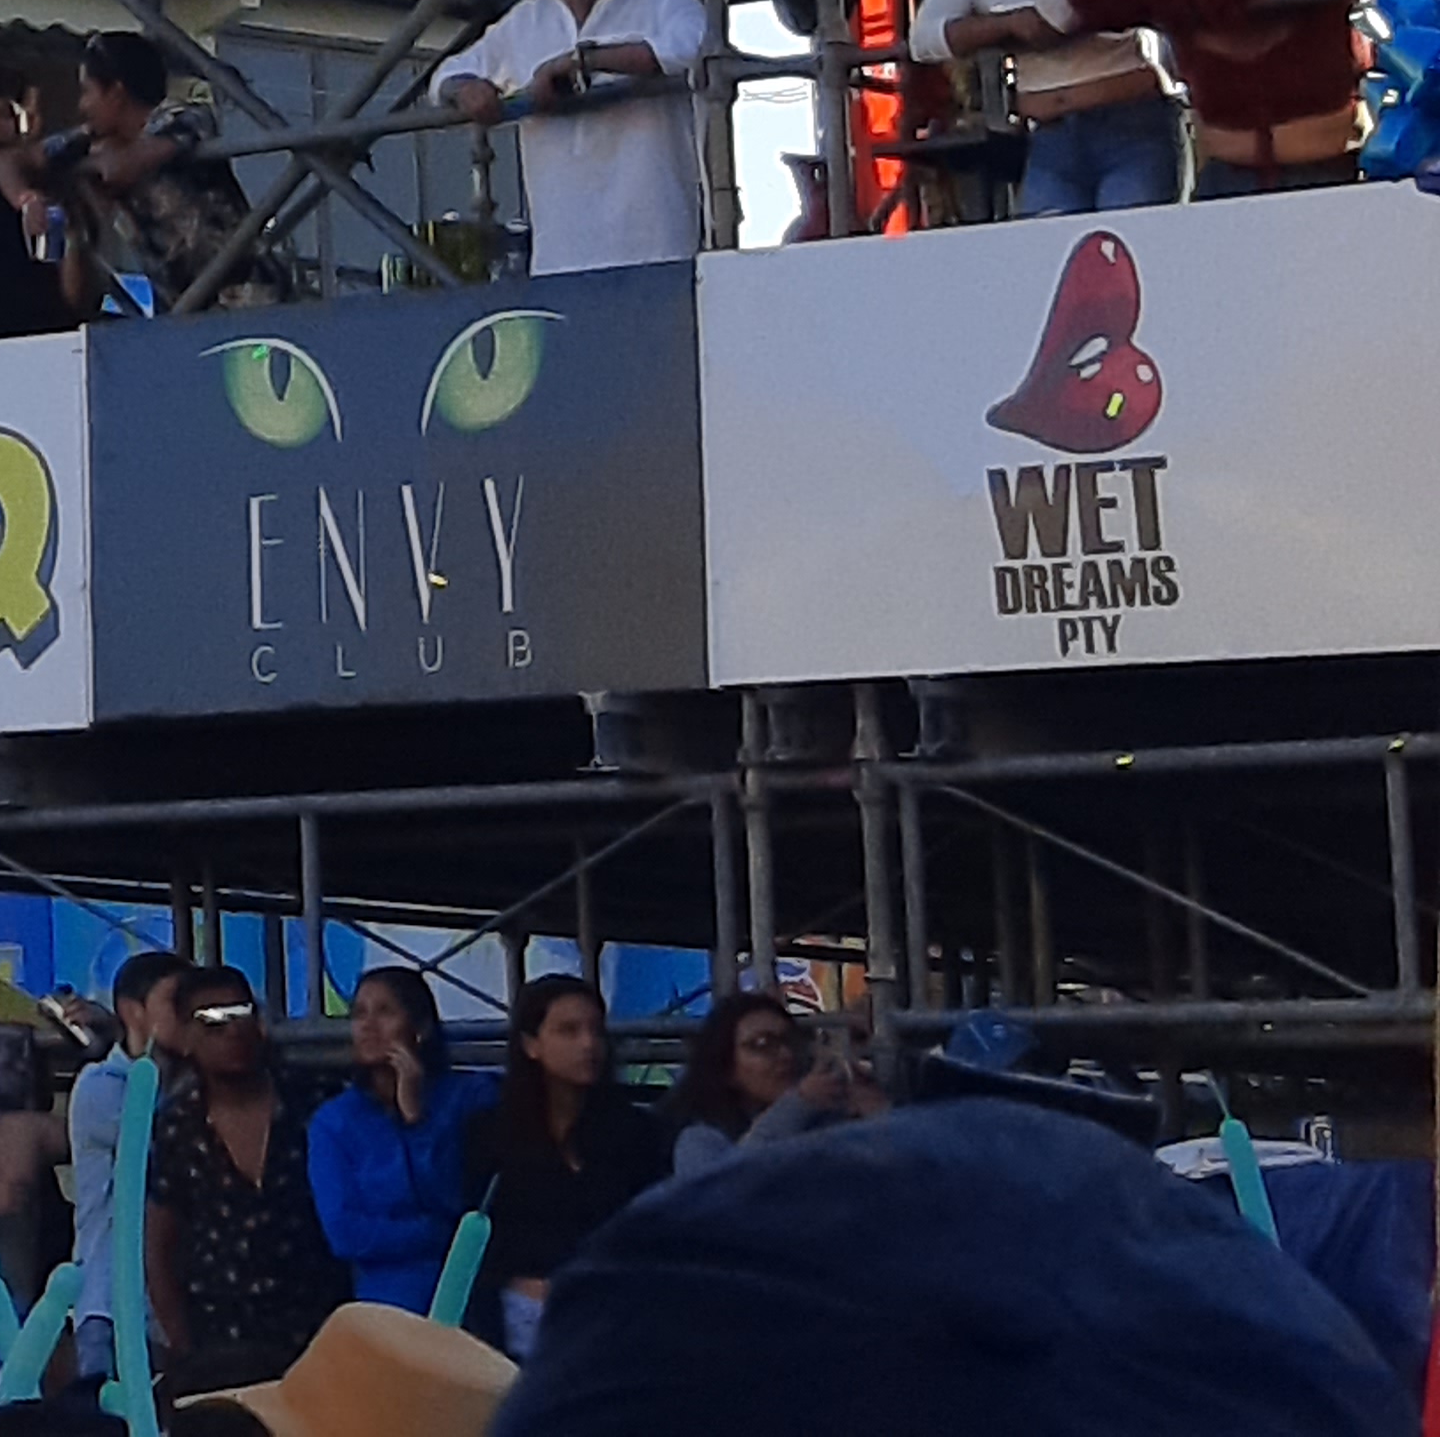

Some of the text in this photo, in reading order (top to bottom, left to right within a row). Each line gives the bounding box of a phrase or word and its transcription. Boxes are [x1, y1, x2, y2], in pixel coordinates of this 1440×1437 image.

[985, 453, 1169, 560] WET
[249, 474, 524, 633] ENVY
[993, 555, 1181, 616] DREAMS
[251, 628, 533, 684] CLUB
[1057, 614, 1122, 658] PTY
